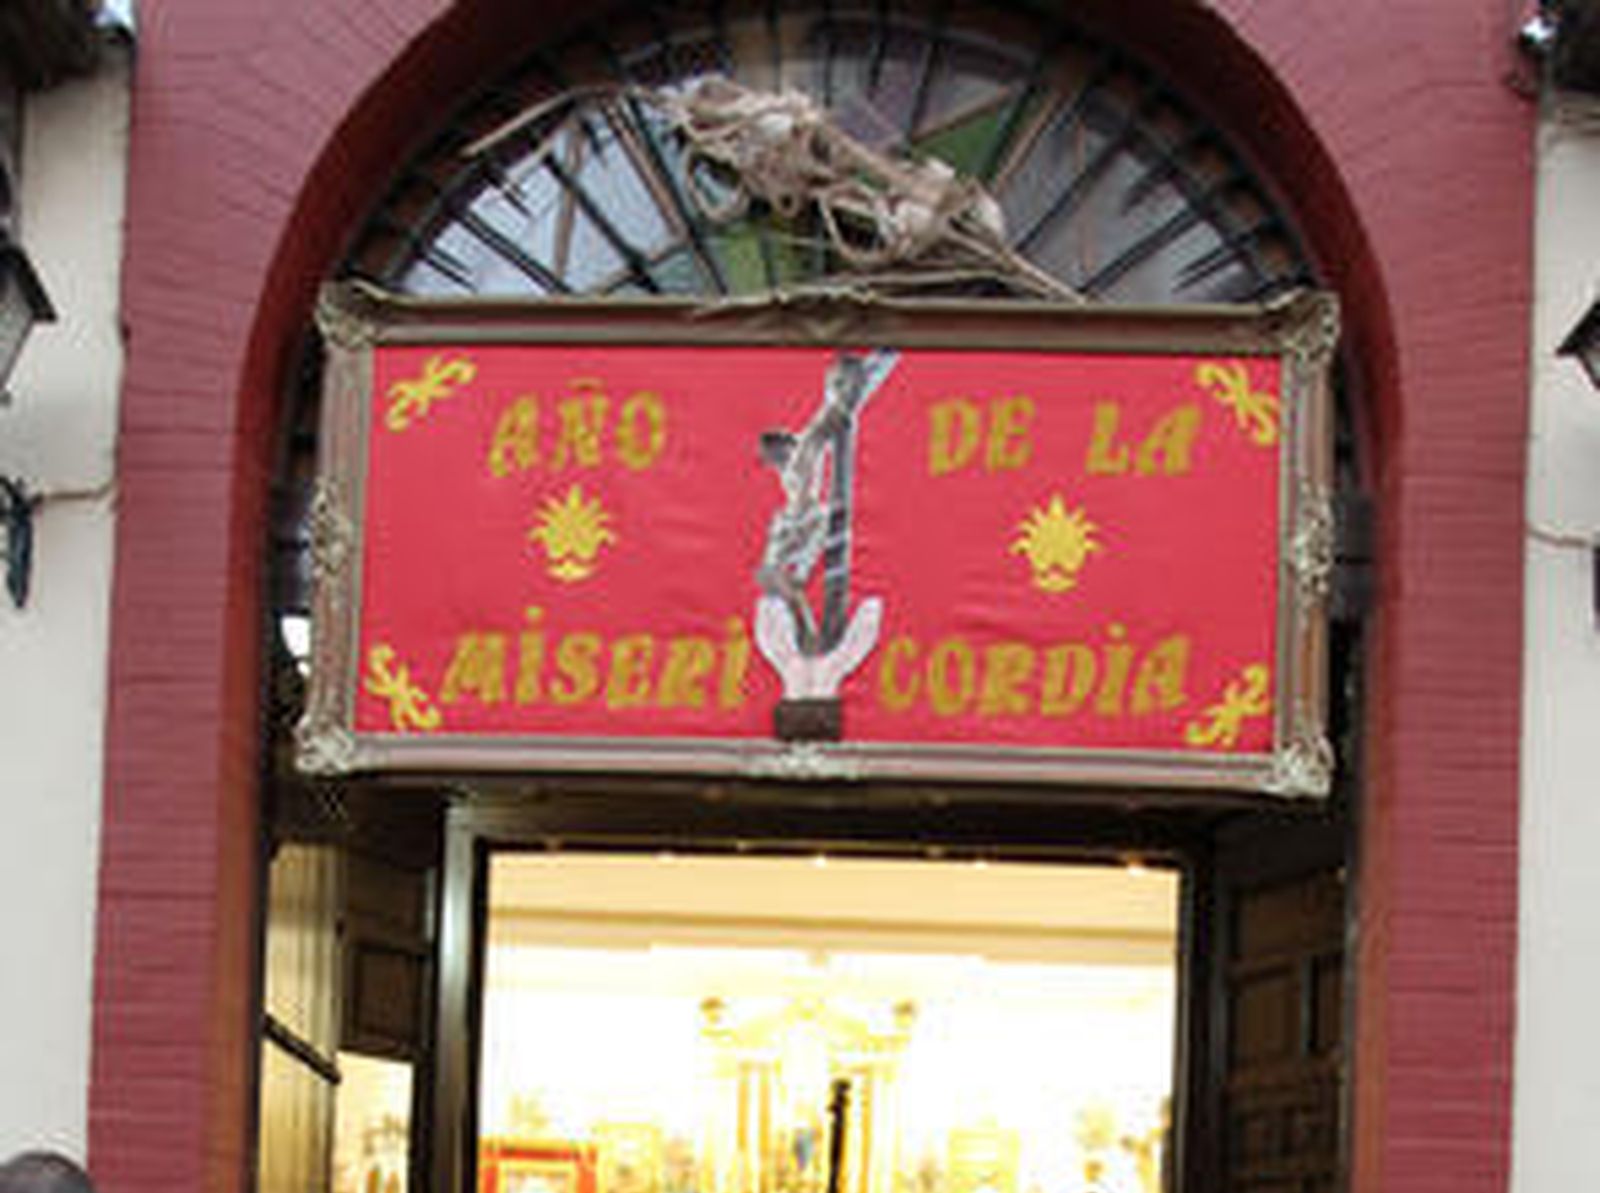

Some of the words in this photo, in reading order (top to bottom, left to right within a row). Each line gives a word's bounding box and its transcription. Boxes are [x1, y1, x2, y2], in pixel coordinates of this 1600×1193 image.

[488, 377, 667, 478] AÑO
[928, 397, 1036, 476] DE
[1085, 402, 1201, 478] LA
